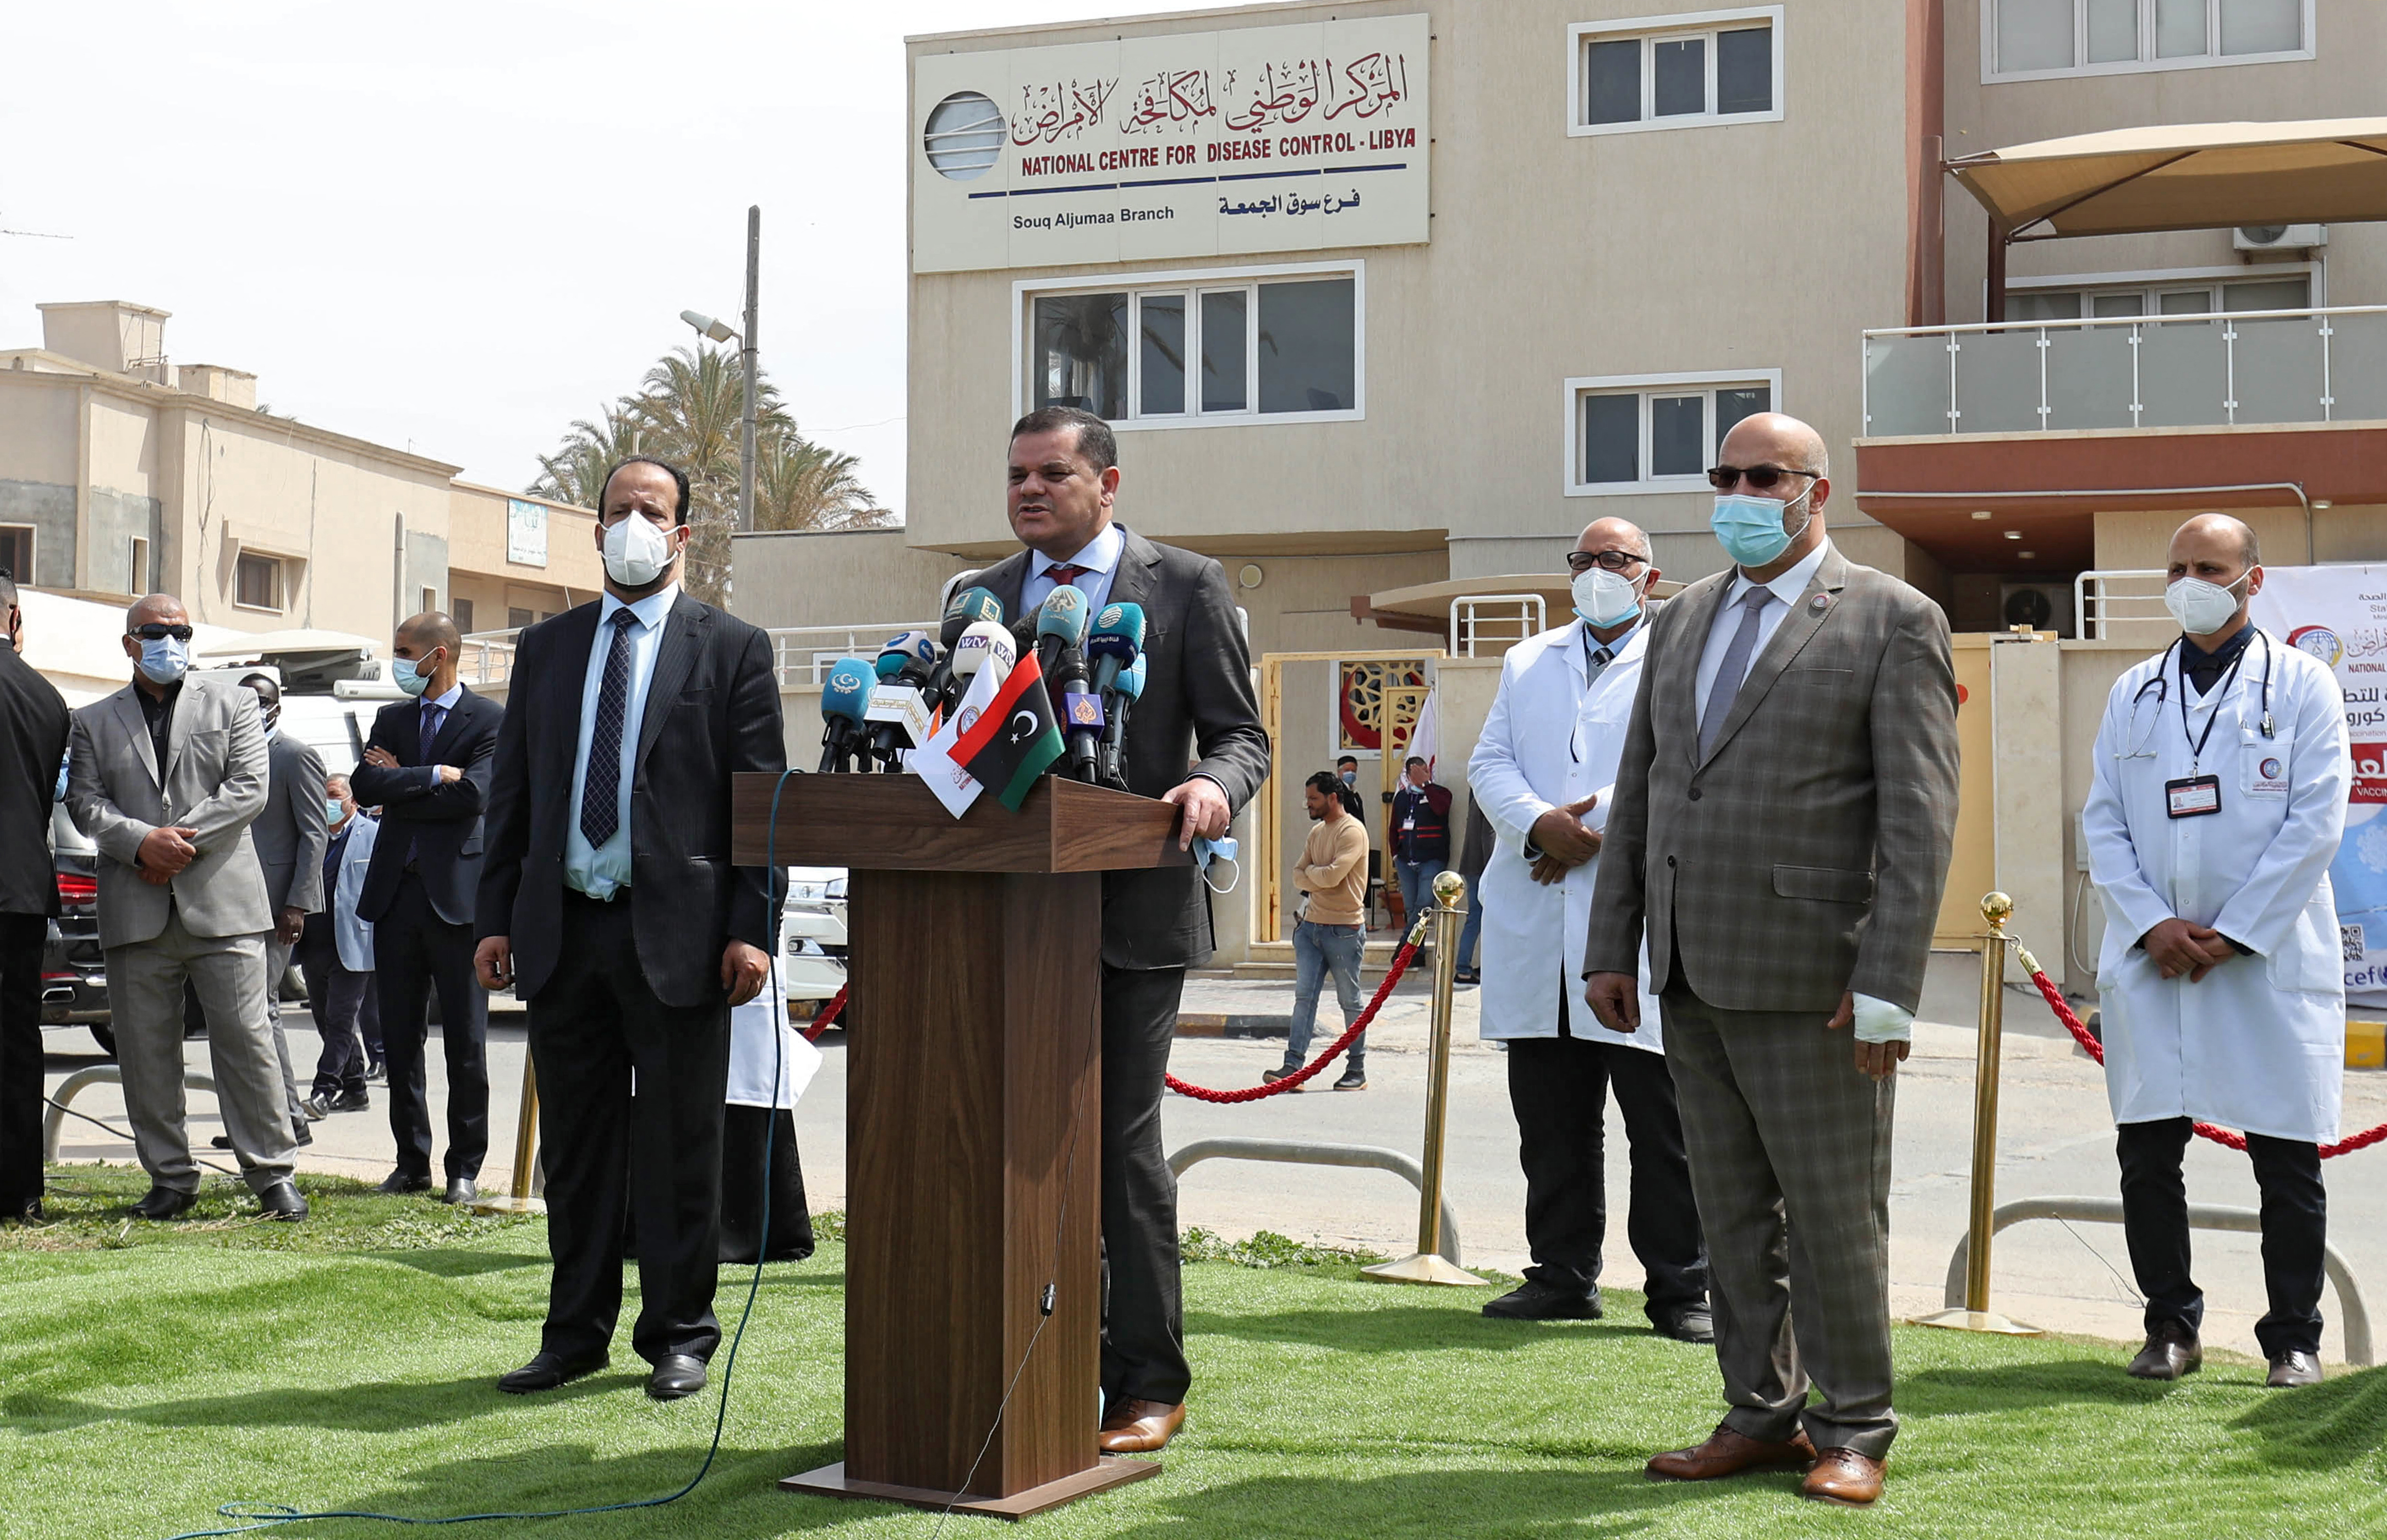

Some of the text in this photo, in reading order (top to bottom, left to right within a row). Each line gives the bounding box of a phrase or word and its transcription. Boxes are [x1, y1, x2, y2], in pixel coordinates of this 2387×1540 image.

[1022, 153, 1095, 176] NATIONAL
[1099, 147, 1159, 171] CENTRE
[1166, 144, 1197, 165] FOR
[1207, 138, 1271, 162] DISEASE
[1279, 132, 1355, 157] CONTROL
[1369, 127, 1416, 150] LIBYA
[1219, 188, 1360, 219] فرع سوق الجمعة
[1013, 206, 1174, 230] Souq Aljumaa Branch
[2369, 604, 2387, 613] Sta
[2348, 663, 2386, 674] NATIONAL
[2345, 966, 2375, 986] cef
